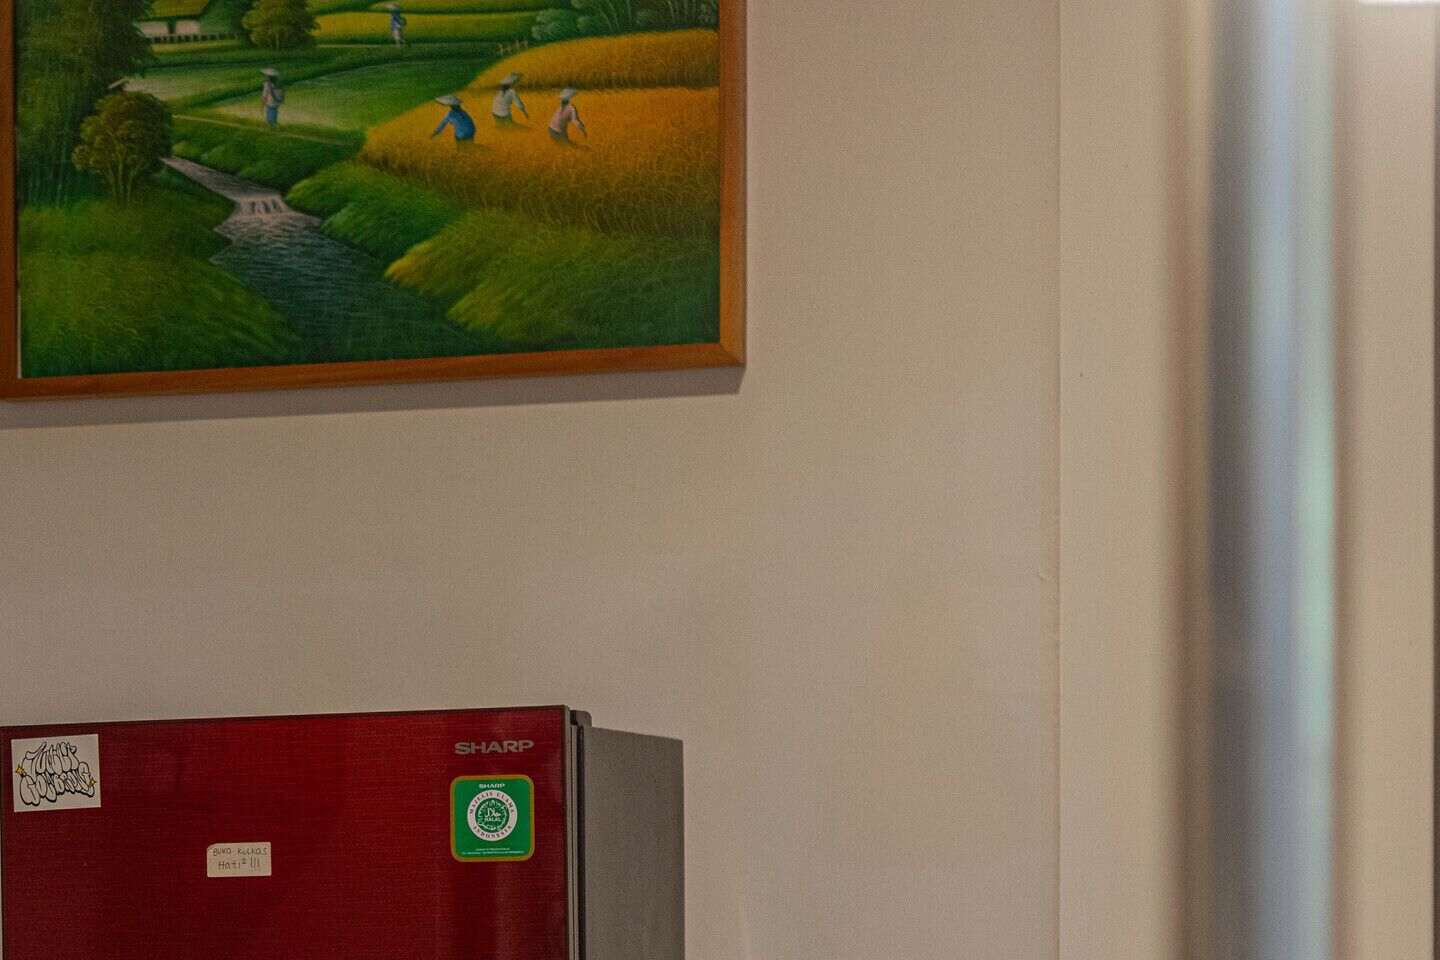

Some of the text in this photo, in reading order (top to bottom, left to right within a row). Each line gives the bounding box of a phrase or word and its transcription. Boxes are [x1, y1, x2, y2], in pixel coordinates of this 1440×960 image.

[454, 740, 535, 756] SHARP
[469, 792, 494, 815] MAJELIS
[496, 792, 515, 814] ULAMA
[473, 825, 512, 839] INDONESIA
